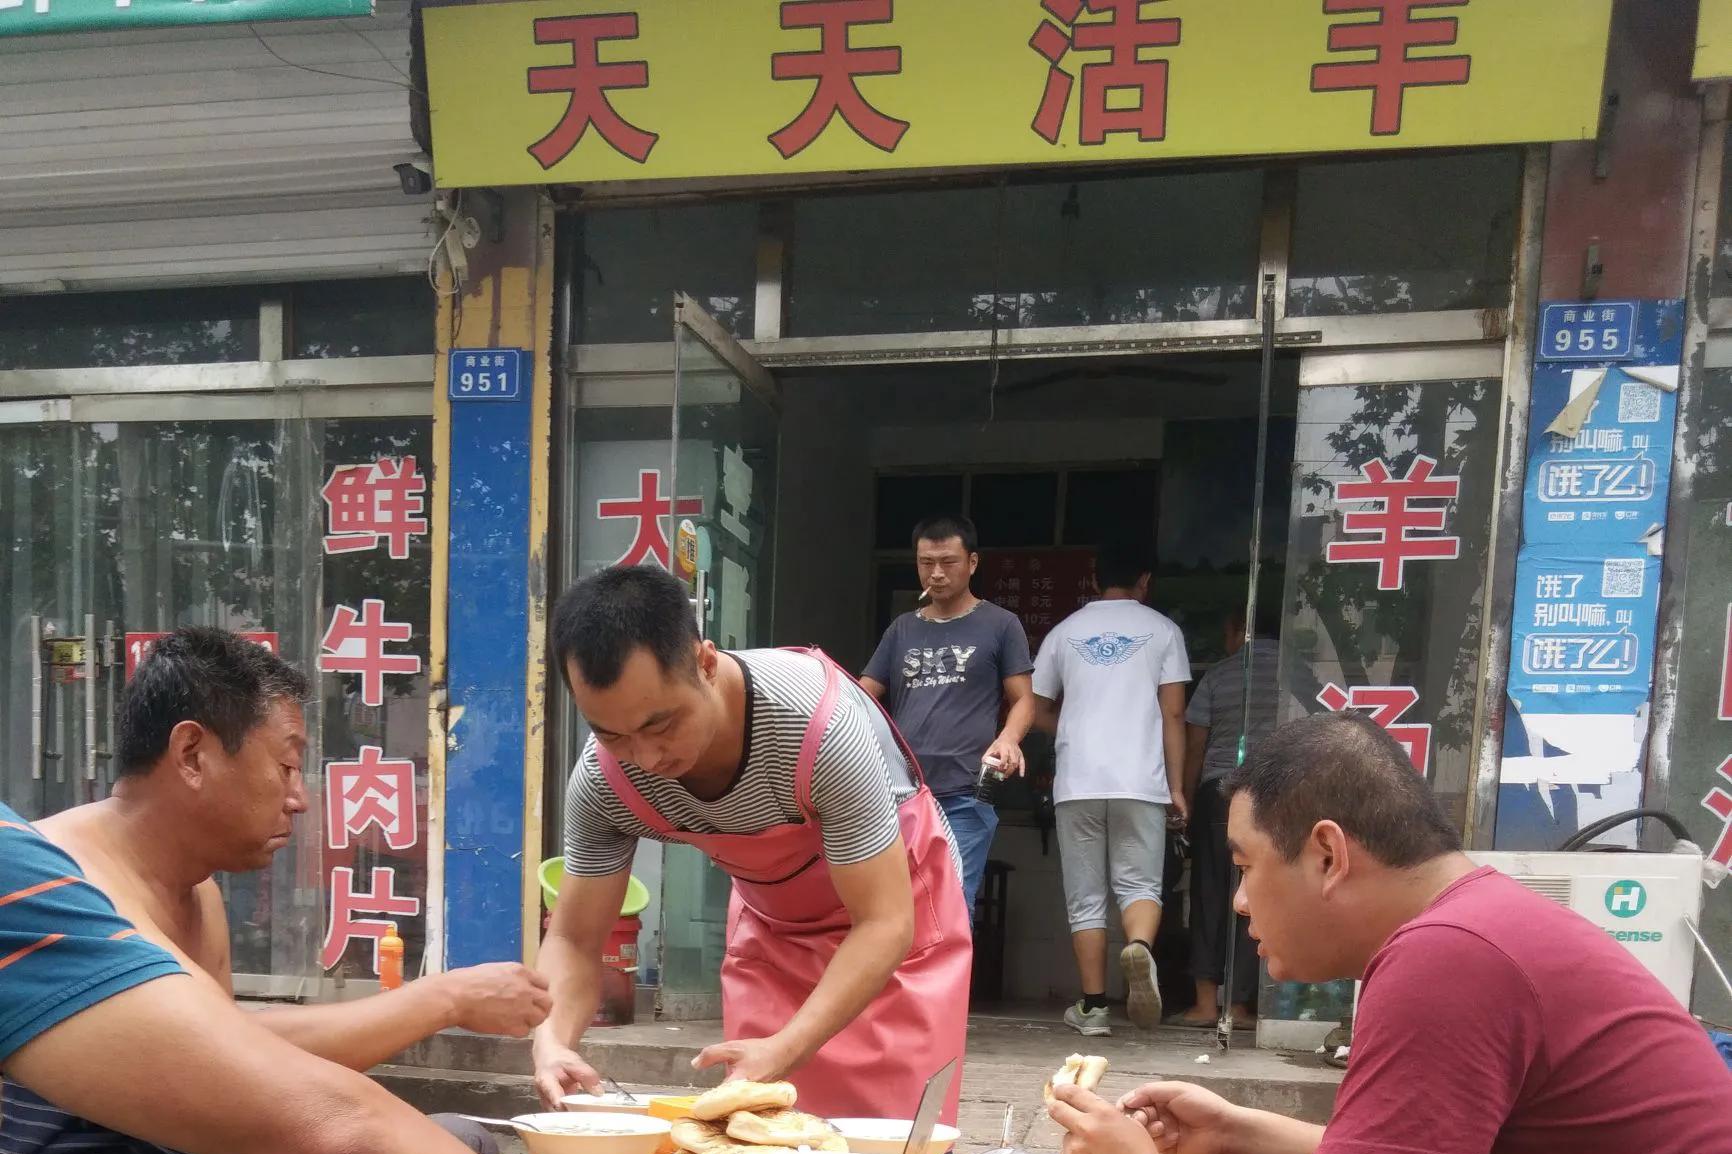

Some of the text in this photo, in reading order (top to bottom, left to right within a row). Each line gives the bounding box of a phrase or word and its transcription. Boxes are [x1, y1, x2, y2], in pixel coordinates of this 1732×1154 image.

[1563, 309, 1617, 323] 商业街
[1555, 329, 1618, 351] 955
[465, 355, 505, 367] 商业街
[460, 372, 508, 392] 951
[1536, 574, 1584, 598] 饿了
[903, 645, 977, 677] SKY
[320, 454, 428, 975] 鲜牛肉片
[1602, 927, 1664, 943] sense
